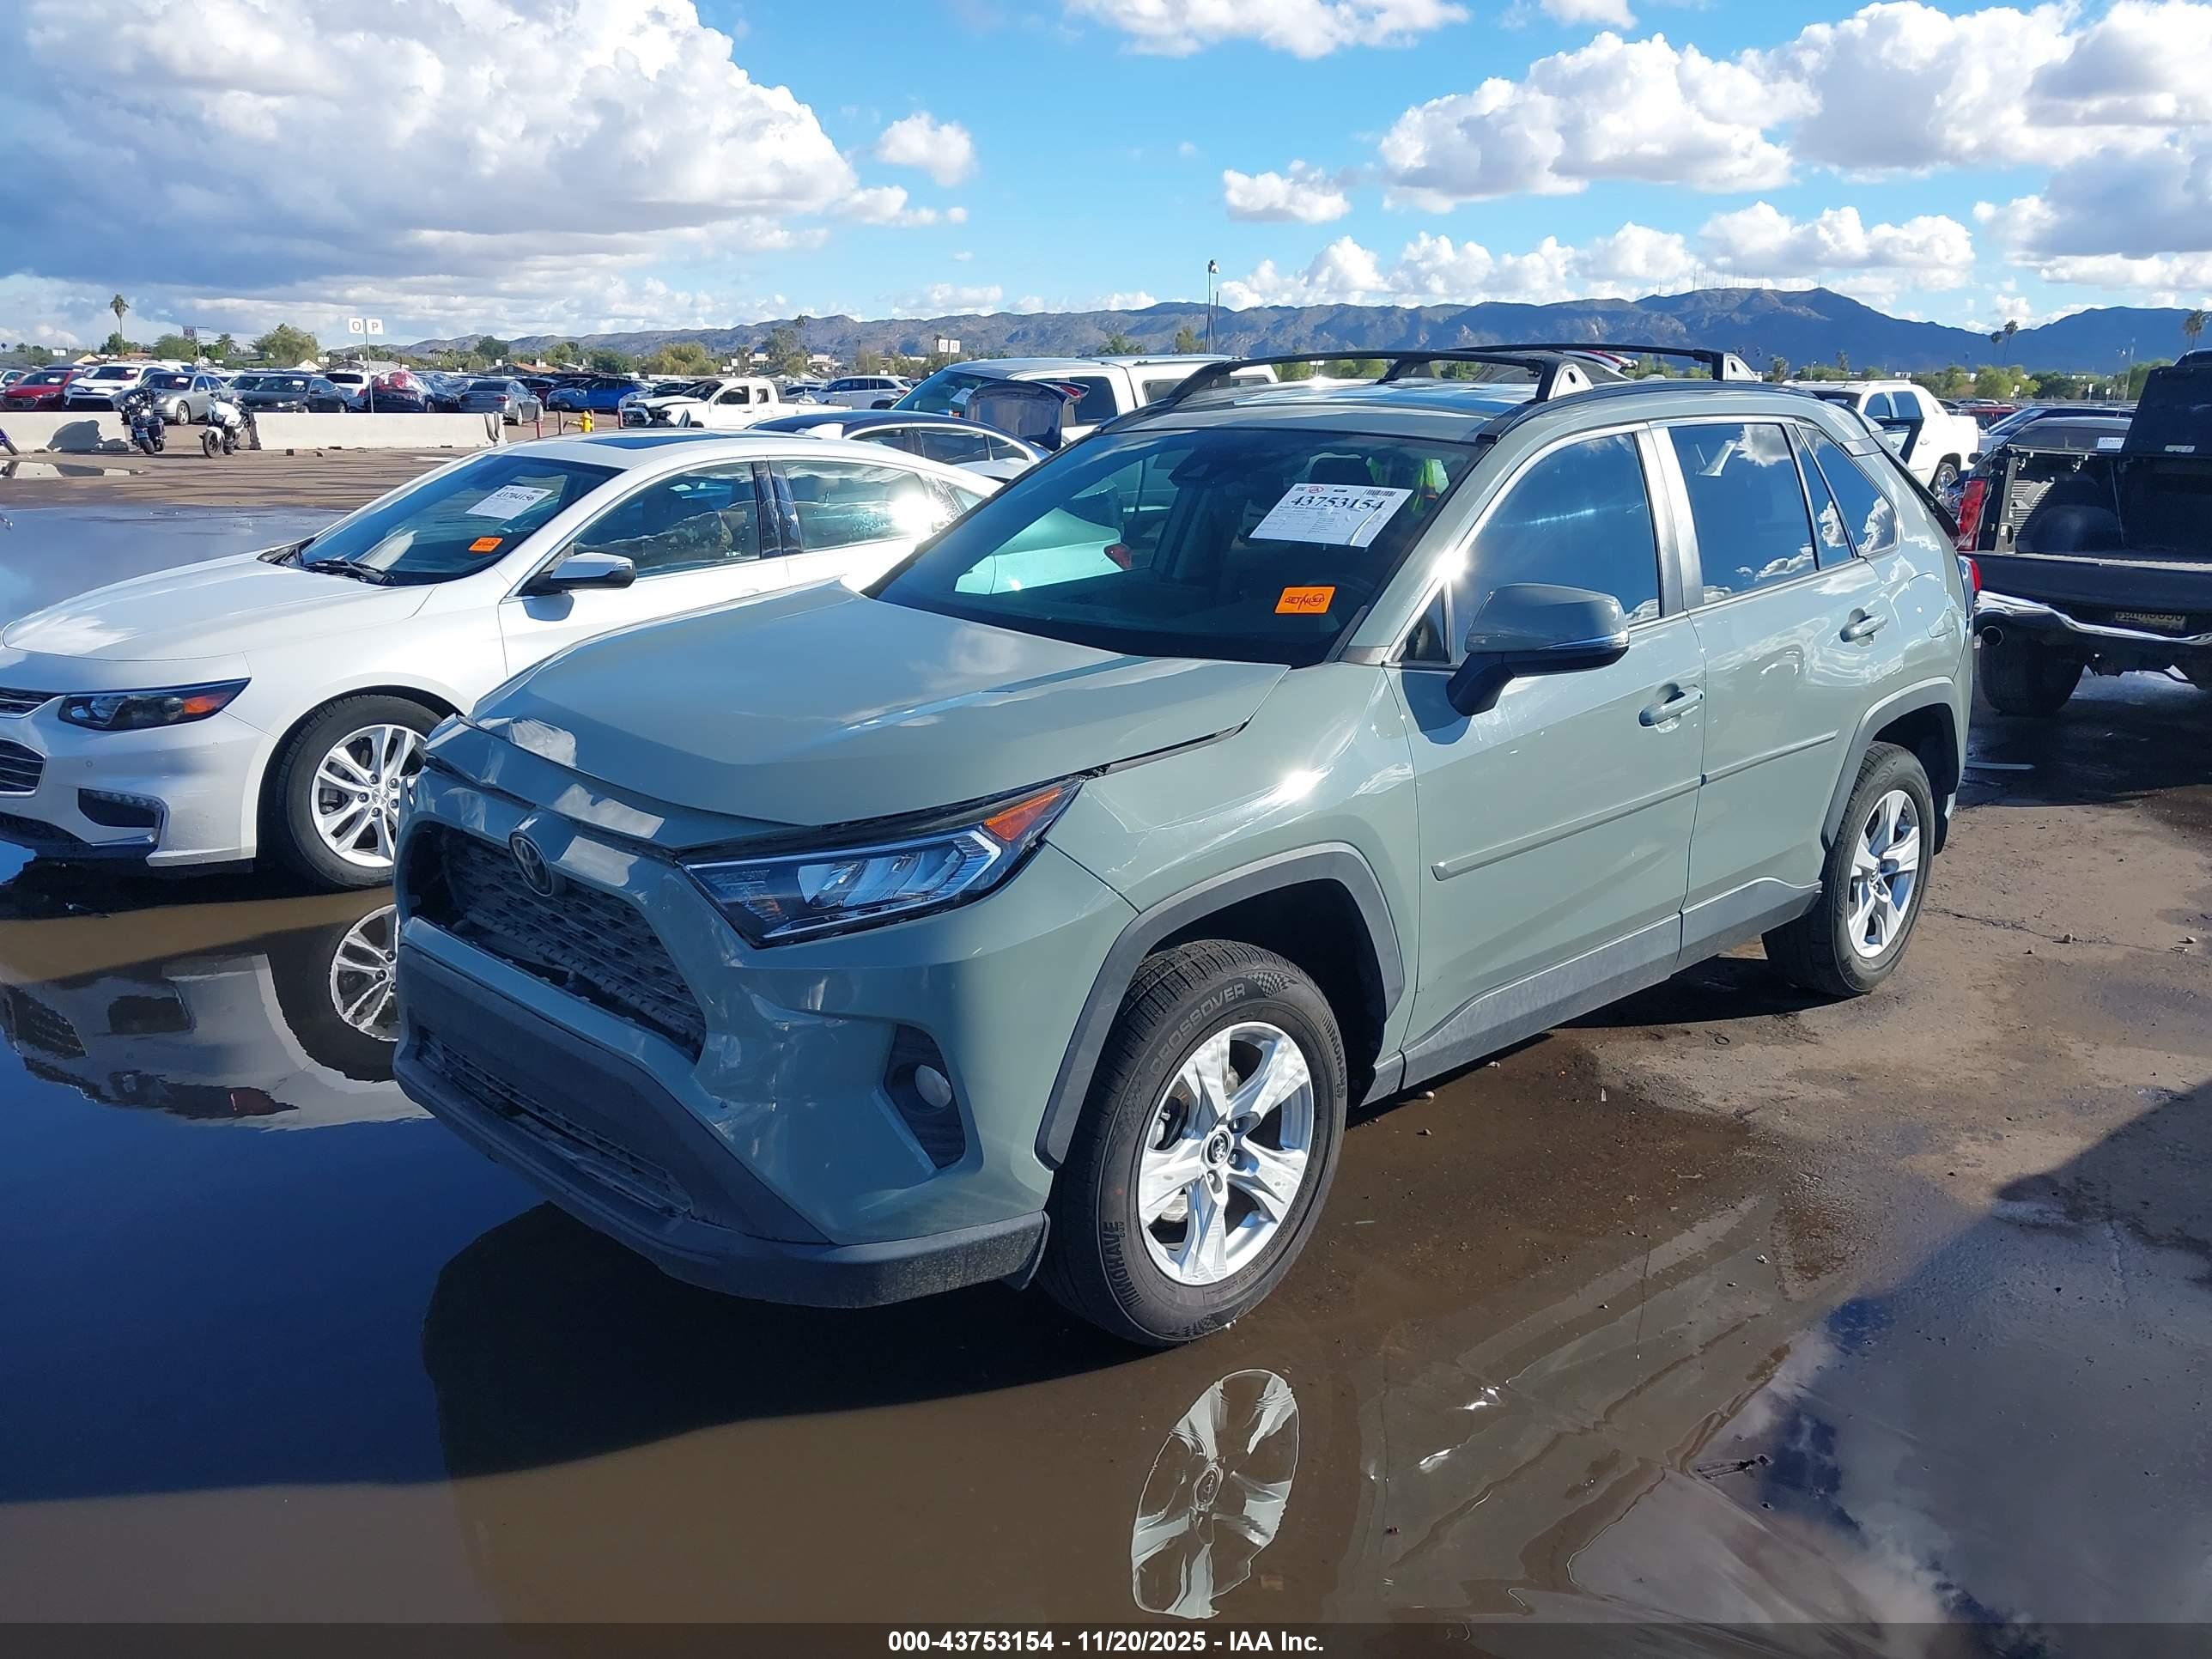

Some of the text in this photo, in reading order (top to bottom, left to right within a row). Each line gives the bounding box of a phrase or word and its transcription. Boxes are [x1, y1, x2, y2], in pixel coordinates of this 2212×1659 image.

[351, 321, 362, 331] O
[371, 322, 379, 331] P
[1291, 495, 1387, 512] 43753154
[1149, 982, 1246, 1073] CROSSOVER
[1102, 1221, 1135, 1295] MOHAVE
